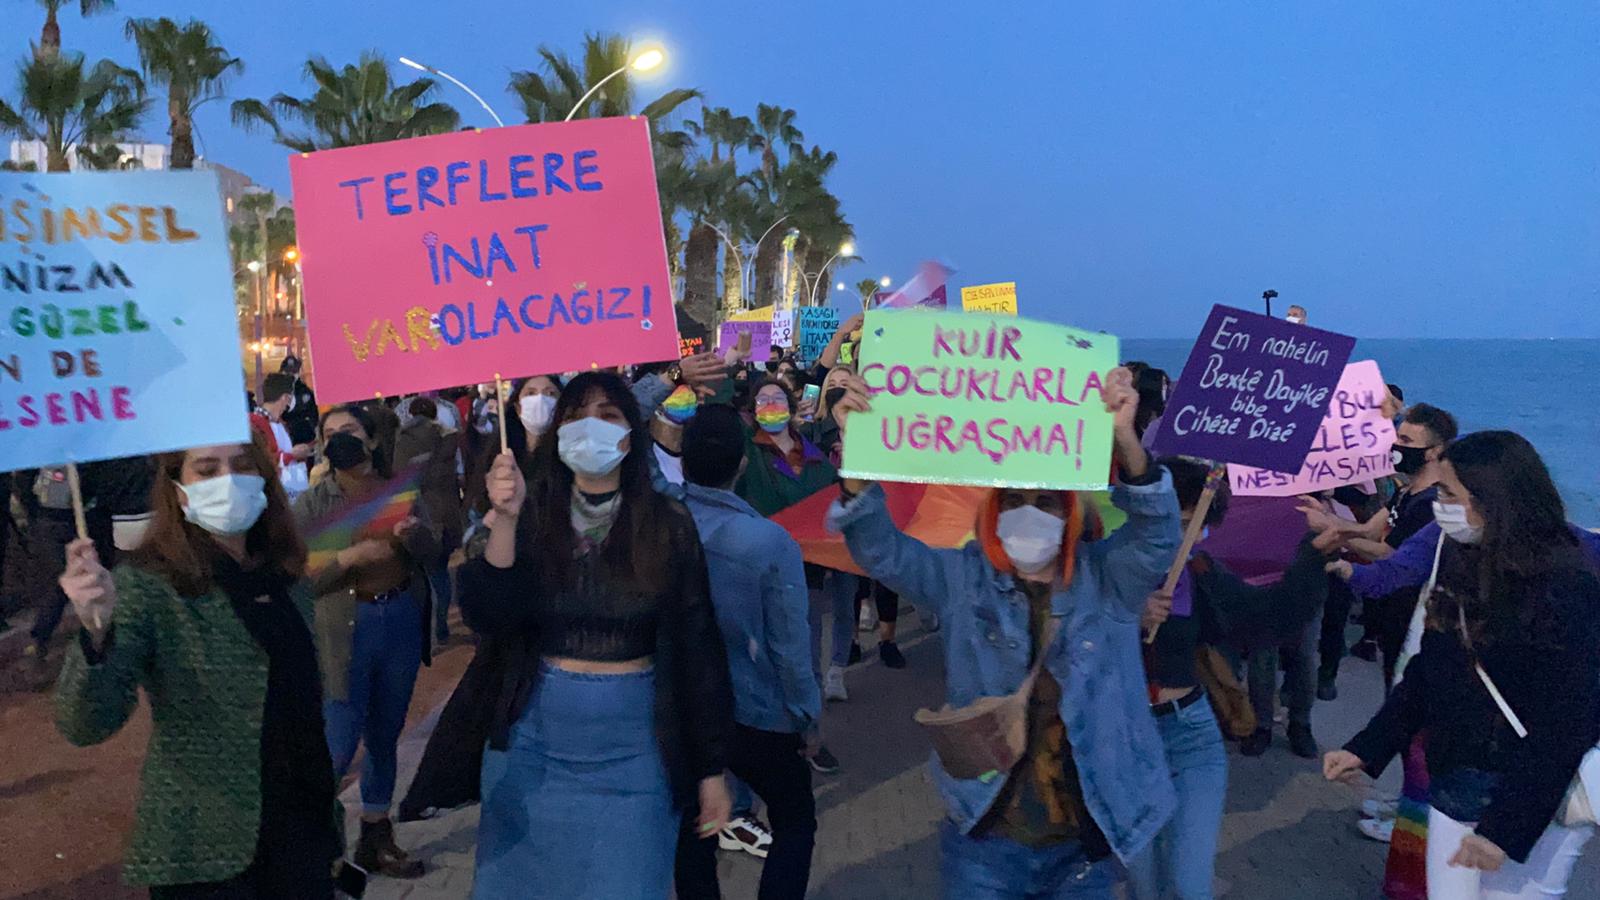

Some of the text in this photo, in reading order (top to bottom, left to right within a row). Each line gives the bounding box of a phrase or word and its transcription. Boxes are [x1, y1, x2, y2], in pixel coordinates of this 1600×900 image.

[339, 150, 603, 219] TERFLERE
[1, 253, 134, 294] NİZM
[423, 224, 549, 285] İNAT
[342, 306, 440, 362] VAR
[1211, 316, 1329, 366] Em nahêlin
[51, 348, 102, 378] DE
[1200, 353, 1264, 392] Bextê
[1230, 392, 1268, 417] bibe
[1326, 390, 1383, 419] BUL
[881, 413, 1084, 470] UĞRAŞMA!
[1309, 421, 1391, 453] LES-
[1237, 468, 1296, 489] MES
